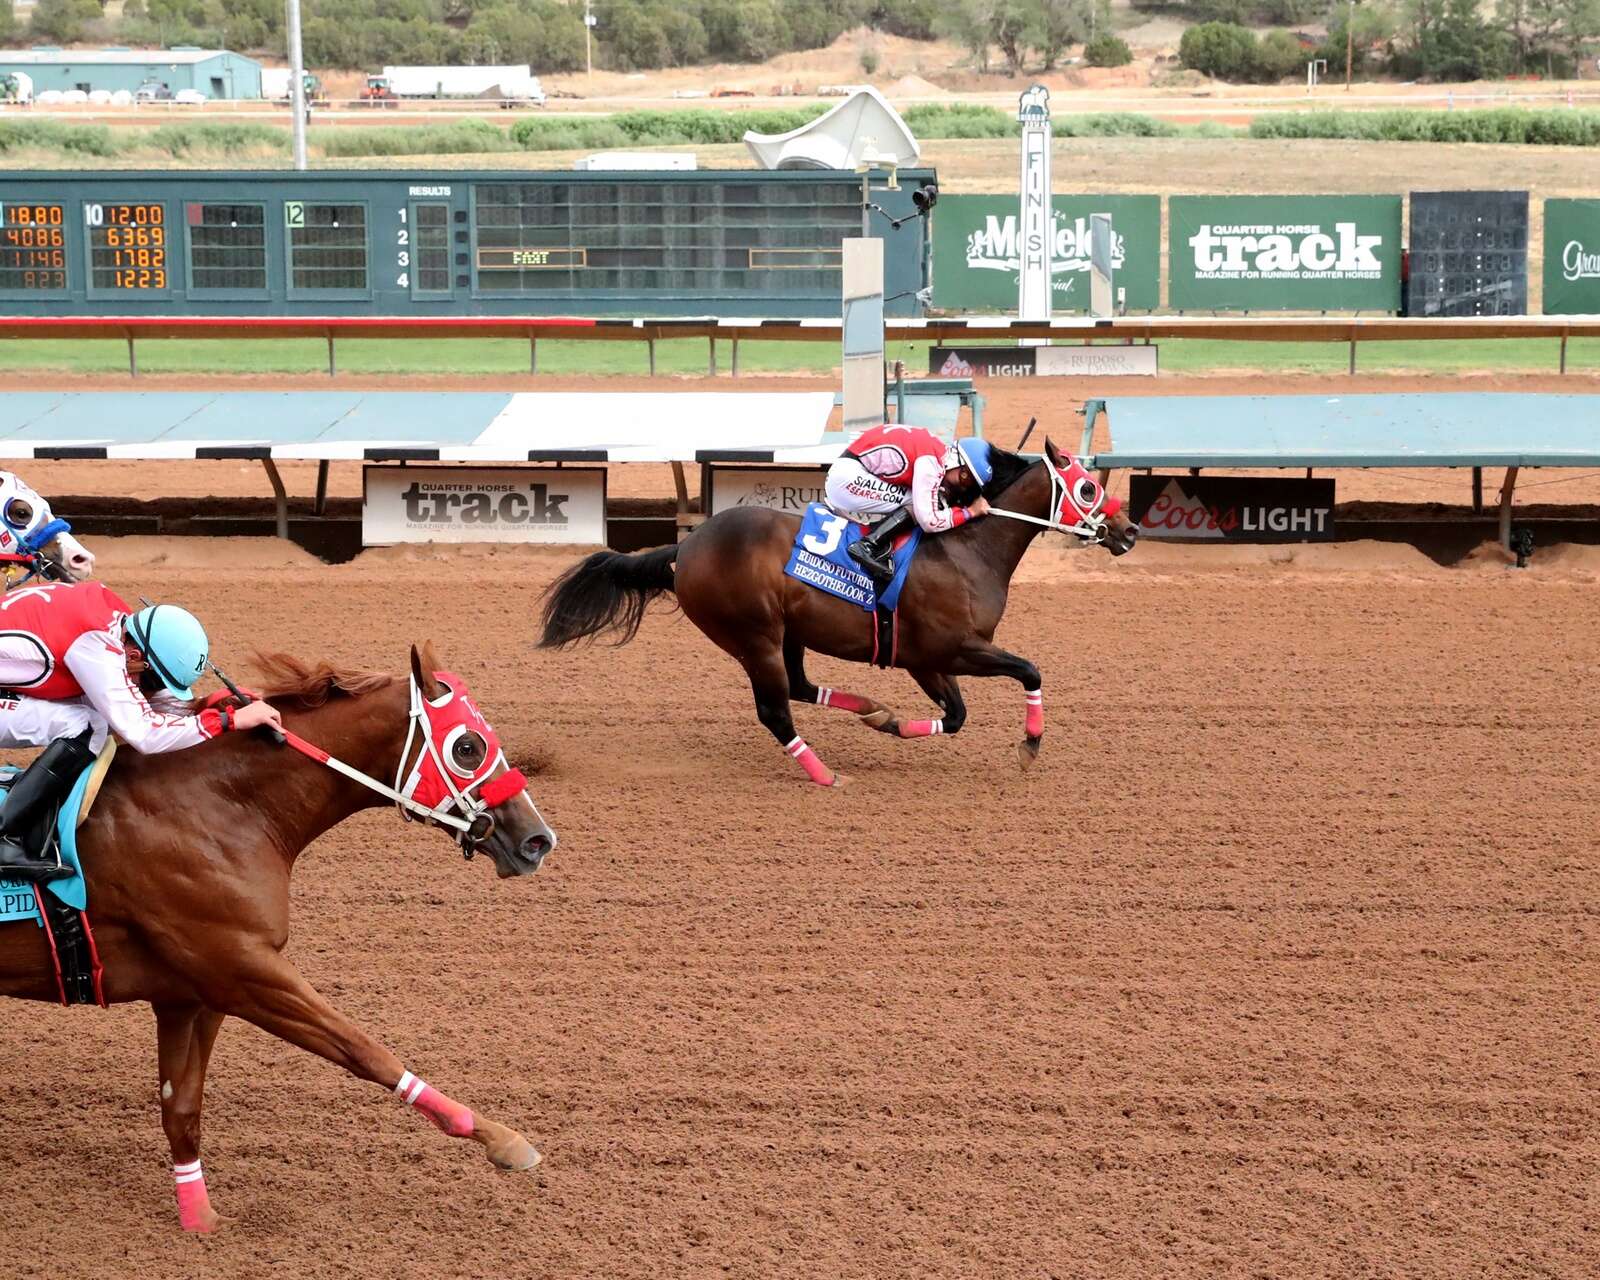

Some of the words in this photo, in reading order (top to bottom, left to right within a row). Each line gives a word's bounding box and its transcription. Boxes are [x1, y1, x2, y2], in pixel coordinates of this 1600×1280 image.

[409, 186, 451, 196] RESULTS
[85, 204, 103, 226] 10
[286, 205, 303, 225] 12
[397, 208, 407, 223] 1
[1028, 152, 1042, 271] FINISH
[7, 229, 62, 246] 4086
[107, 228, 163, 246] 6369
[397, 230, 409, 245] 2
[1213, 225, 1273, 234] QUARTER
[1276, 225, 1320, 234] HORSE
[1189, 222, 1382, 272] track
[15, 251, 63, 267] 1146
[115, 249, 163, 267] 1782
[398, 251, 410, 267] 3
[24, 272, 64, 288] 823
[116, 270, 165, 288] 1223
[396, 273, 409, 288] 4
[1195, 271, 1239, 279] MAGAZINE
[1241, 271, 1259, 279] FOR
[1261, 271, 1300, 279] RUNNING
[1302, 271, 1343, 279] QUARTER
[1345, 271, 1381, 279] HORSES
[988, 365, 1032, 377] LIGHT
[421, 483, 473, 492] QUARTER
[477, 484, 516, 492] HORSE
[402, 482, 569, 523] track
[1140, 494, 1240, 531] Coors
[1242, 507, 1329, 532] LIGHT
[802, 508, 848, 556] 3
[798, 549, 835, 577] RUIDOSO
[793, 563, 866, 604] HEZGOTHELOOK
